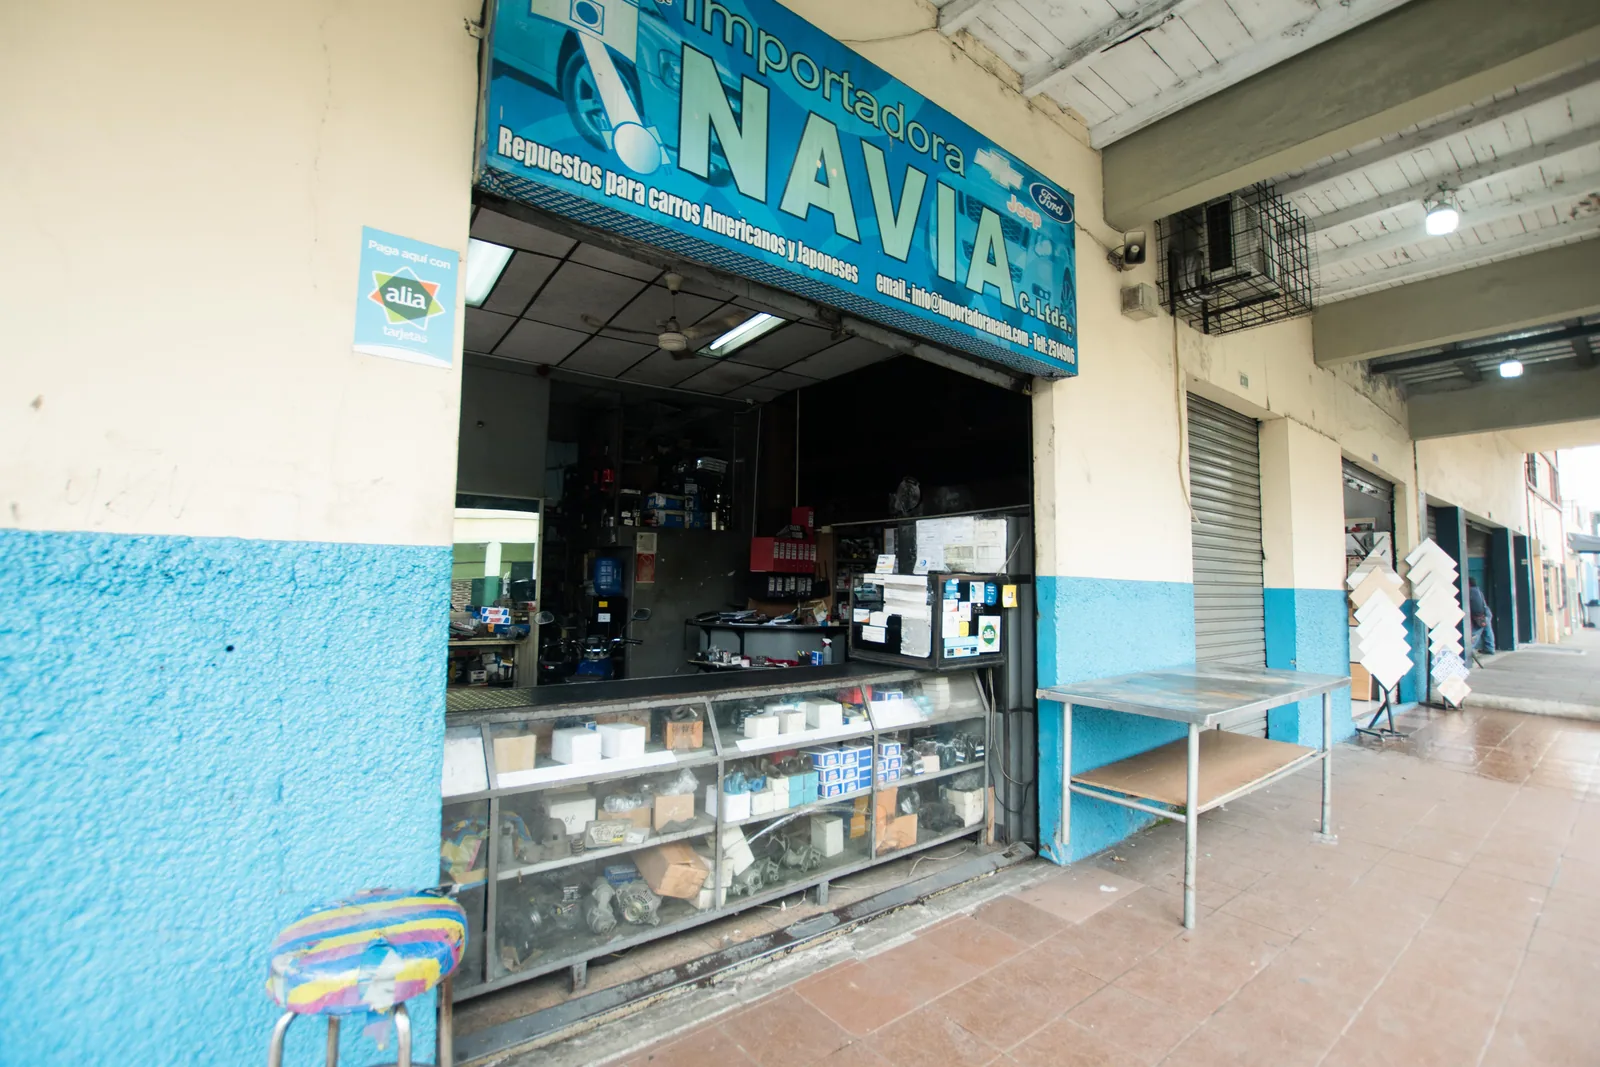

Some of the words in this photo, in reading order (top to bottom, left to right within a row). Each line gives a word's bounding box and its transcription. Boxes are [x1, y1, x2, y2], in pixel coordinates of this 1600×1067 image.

[678, 41, 1018, 309] NAVIA
[498, 125, 603, 190] Repuestos
[605, 169, 646, 206] para
[702, 203, 786, 257] Americanos
[787, 238, 797, 263] y
[796, 240, 860, 284] Japoneses
[1006, 194, 1042, 230] Jeep
[368, 240, 399, 256] Paga
[429, 257, 451, 270] con
[385, 286, 426, 309] alia
[383, 326, 428, 344] tarjetas
[911, 284, 1029, 348] info@importadoranavia.com
[1048, 338, 1075, 365] 2514906
